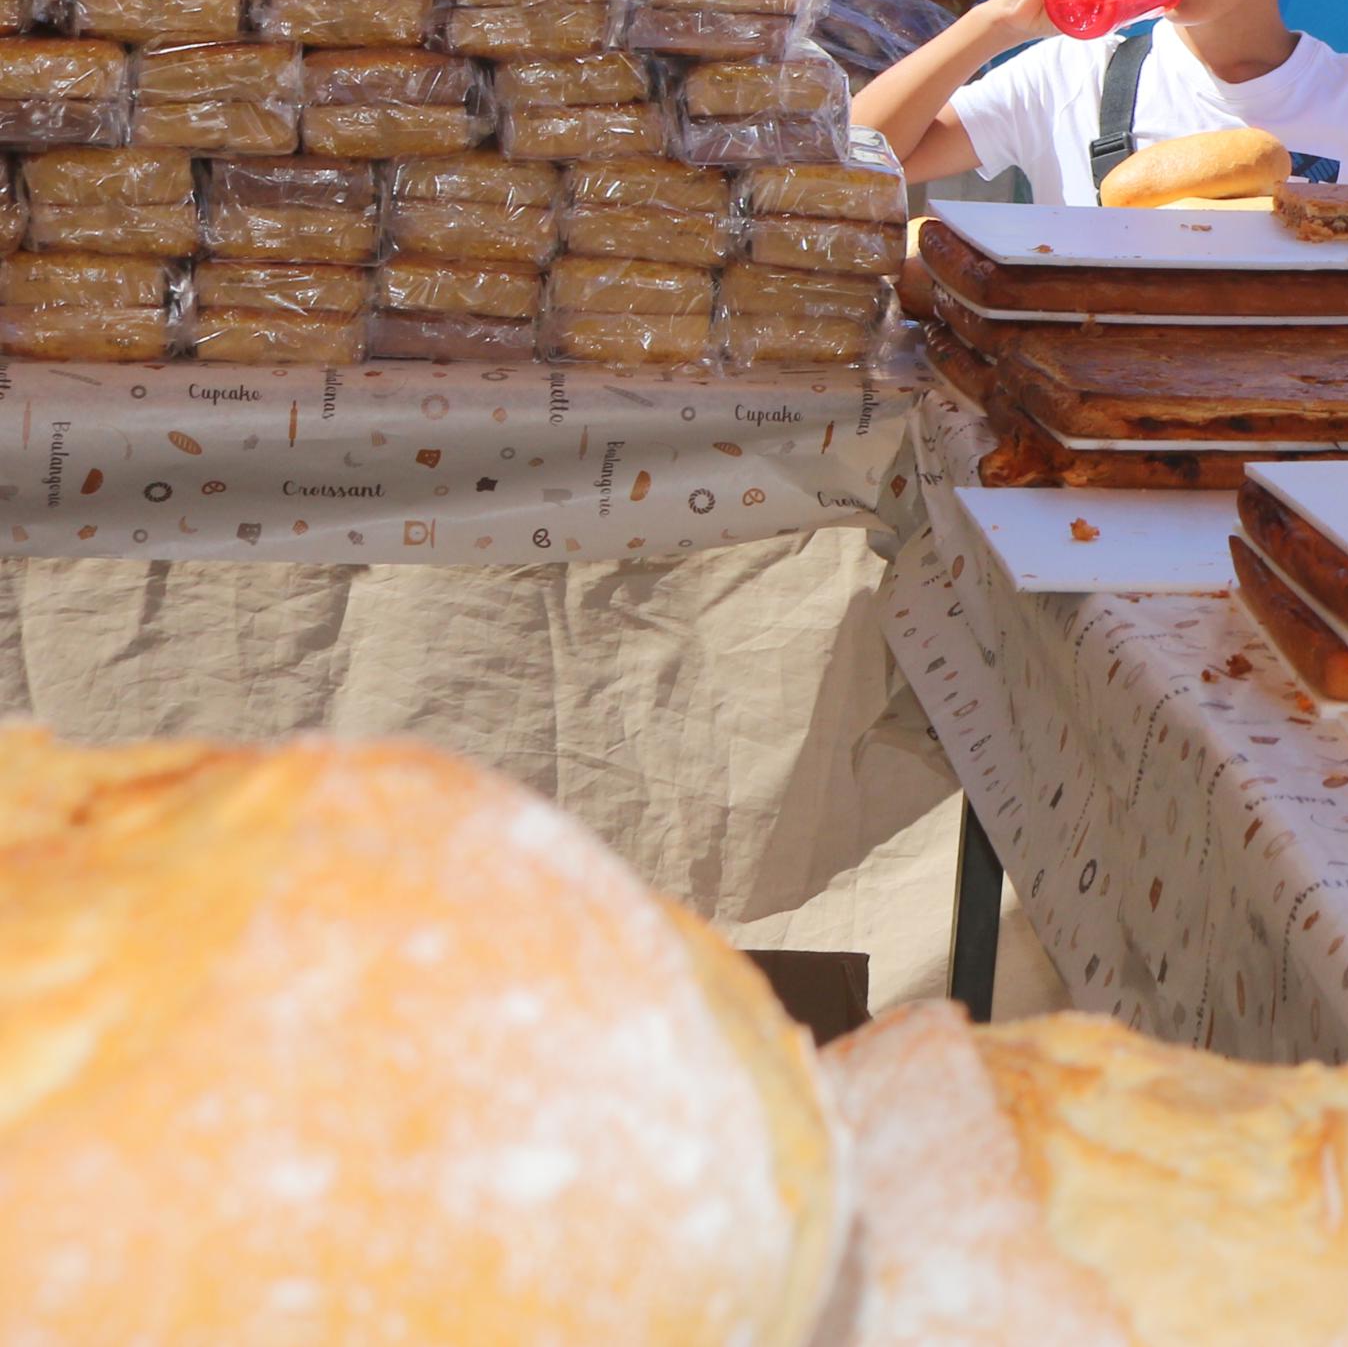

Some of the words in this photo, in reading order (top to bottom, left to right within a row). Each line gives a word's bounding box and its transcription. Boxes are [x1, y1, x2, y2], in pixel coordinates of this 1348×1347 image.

[188, 383, 262, 405] Cupcake
[735, 404, 803, 427] Cupcake
[42, 421, 71, 508] Boulangerie
[282, 480, 386, 499] Croissant
[594, 441, 626, 518] Boulangerie
